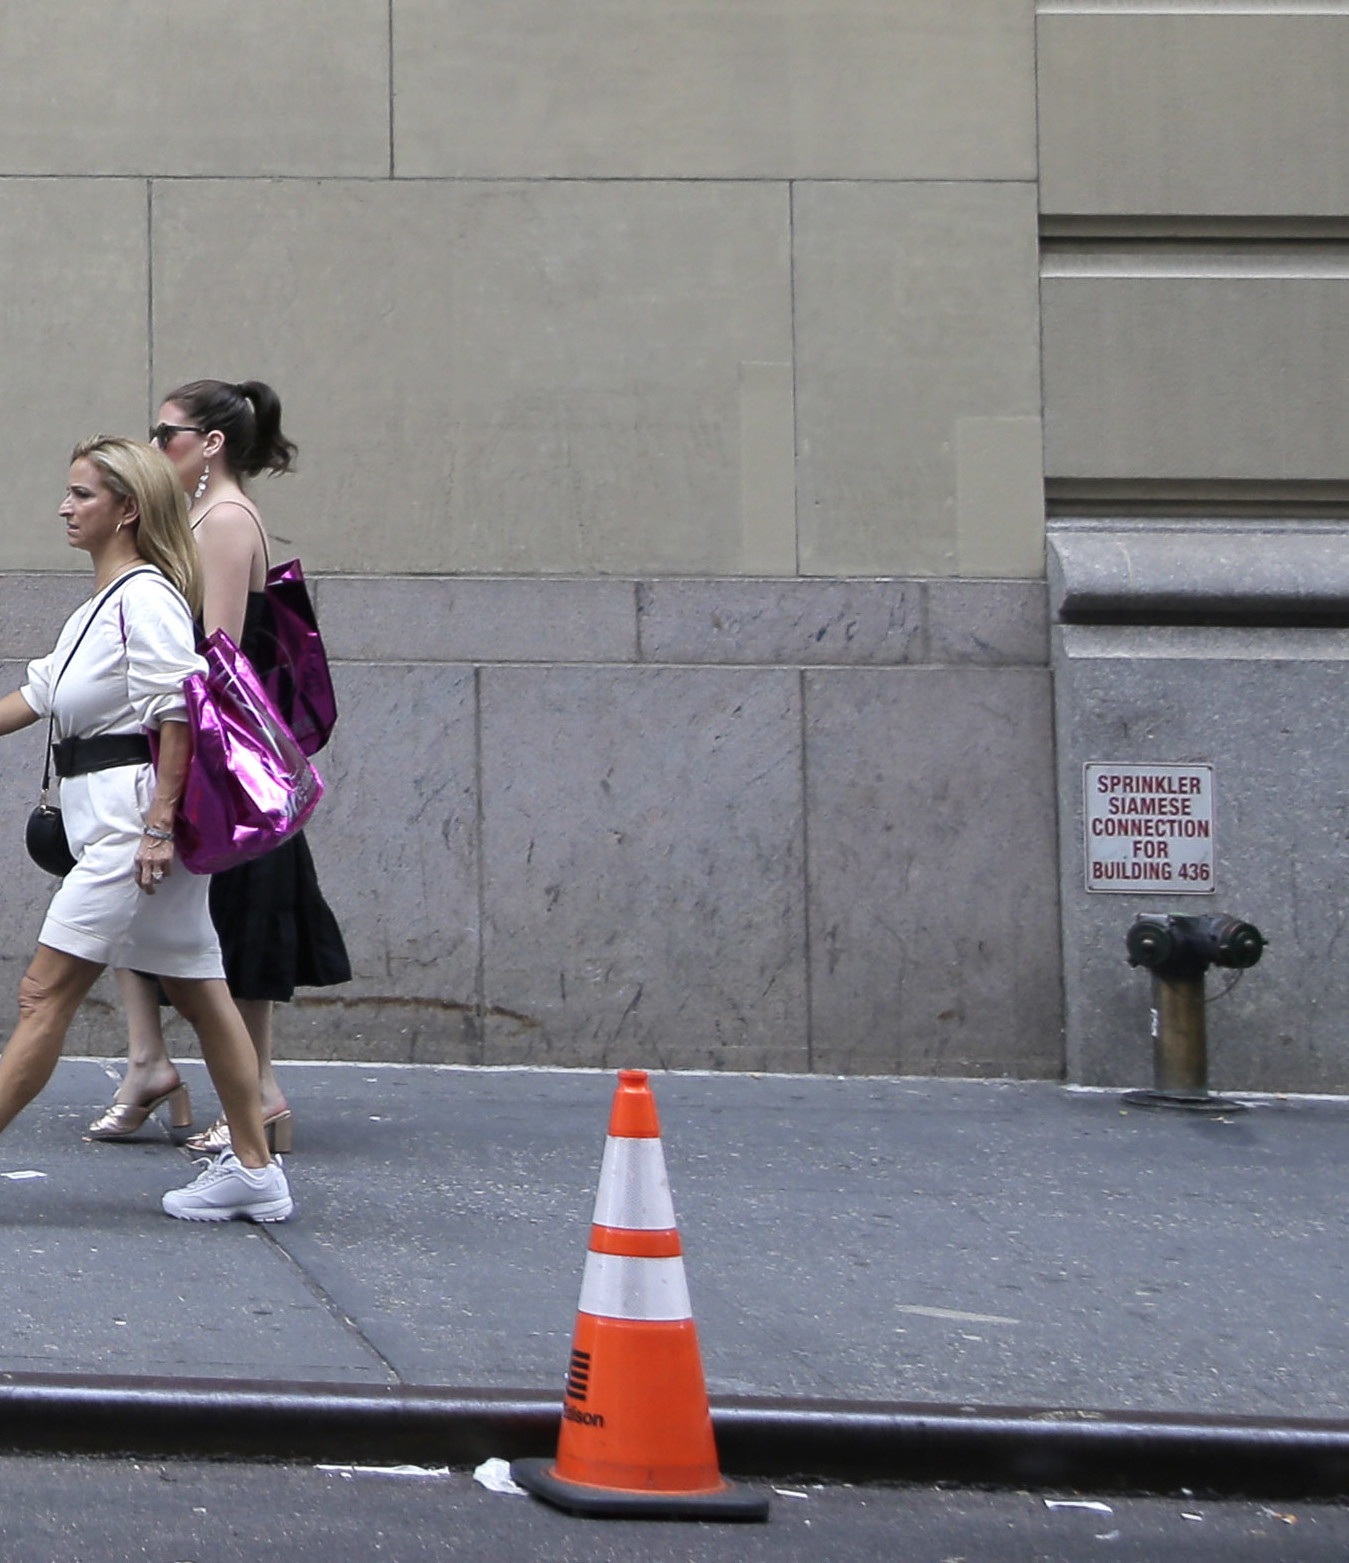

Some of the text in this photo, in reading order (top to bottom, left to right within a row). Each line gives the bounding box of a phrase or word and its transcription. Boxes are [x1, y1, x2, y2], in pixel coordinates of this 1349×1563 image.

[1097, 774, 1202, 796] SPRINKLER
[1108, 796, 1192, 816] SIAMESE
[1091, 817, 1210, 838] CONNECTION
[1132, 840, 1169, 859] FOR
[1092, 861, 1211, 881] BUILDING 436
